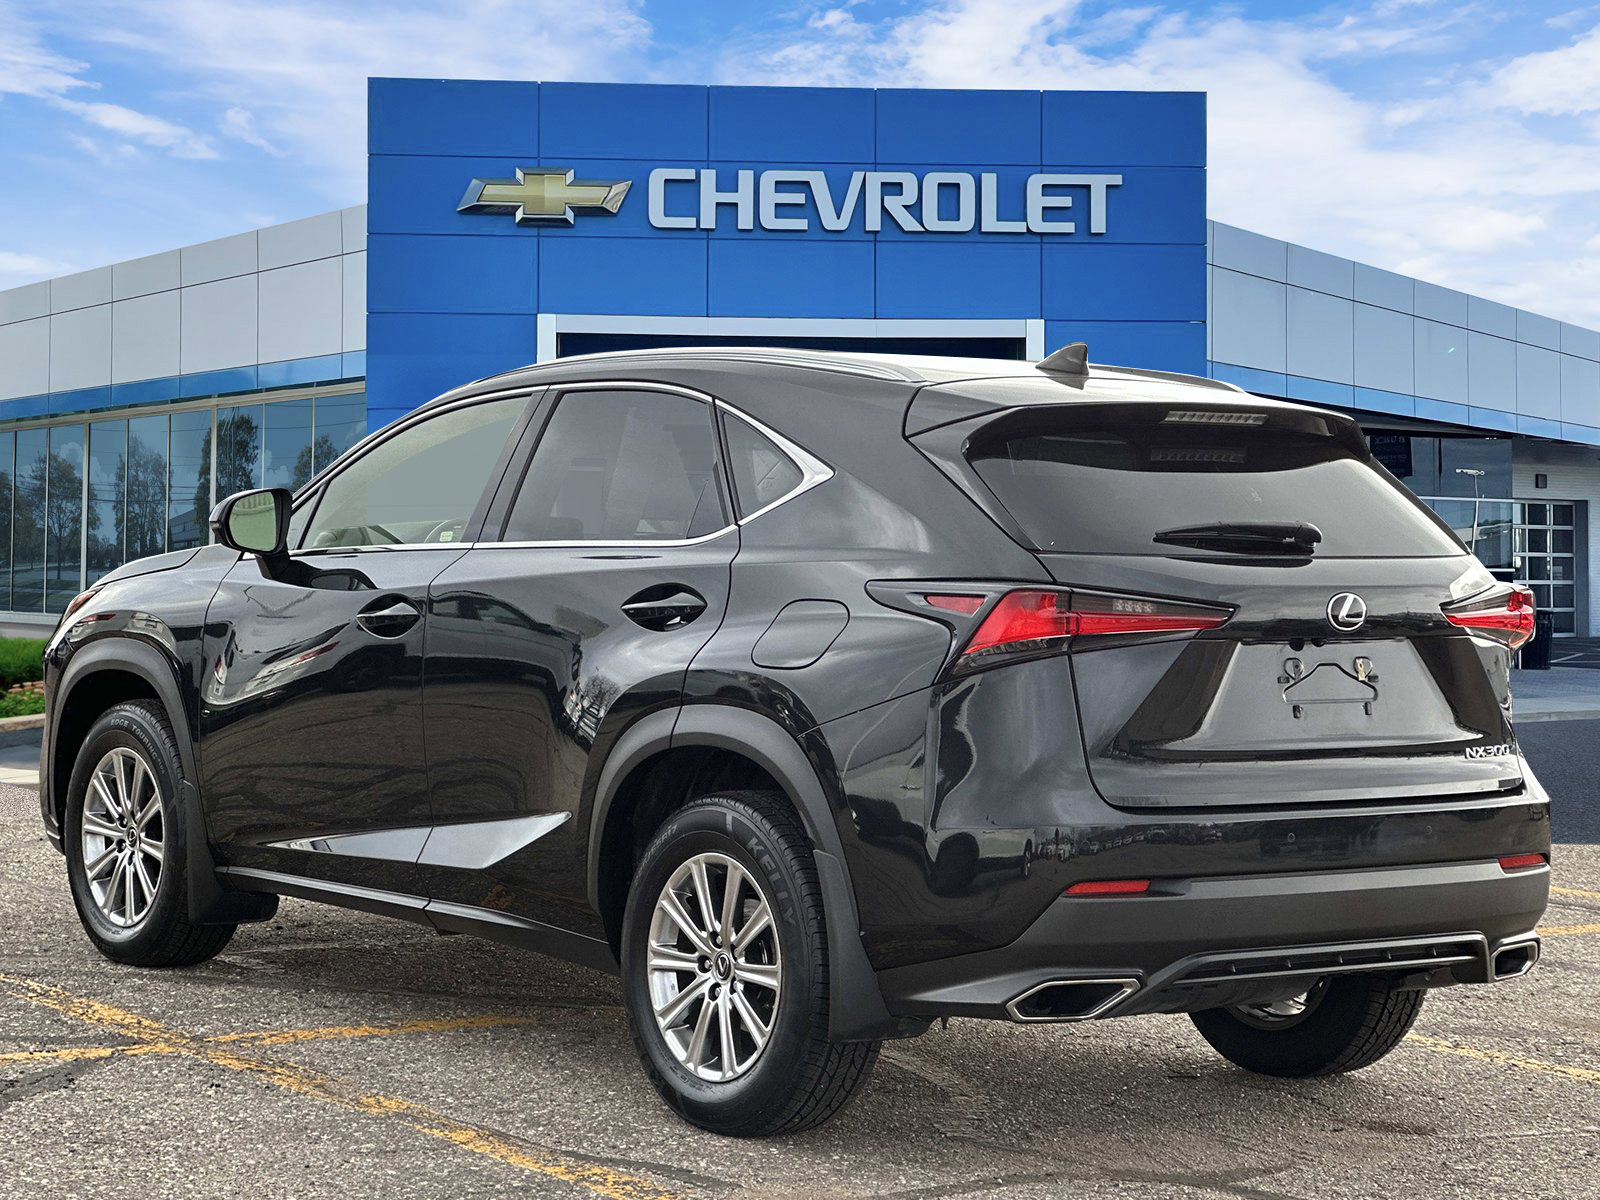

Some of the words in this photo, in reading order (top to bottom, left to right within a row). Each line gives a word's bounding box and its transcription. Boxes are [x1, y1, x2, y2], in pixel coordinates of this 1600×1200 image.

[648, 168, 1123, 234] CHEVROLET
[131, 723, 158, 760] TOURING
[1464, 743, 1511, 760] NX300
[746, 836, 797, 927] KELLY
